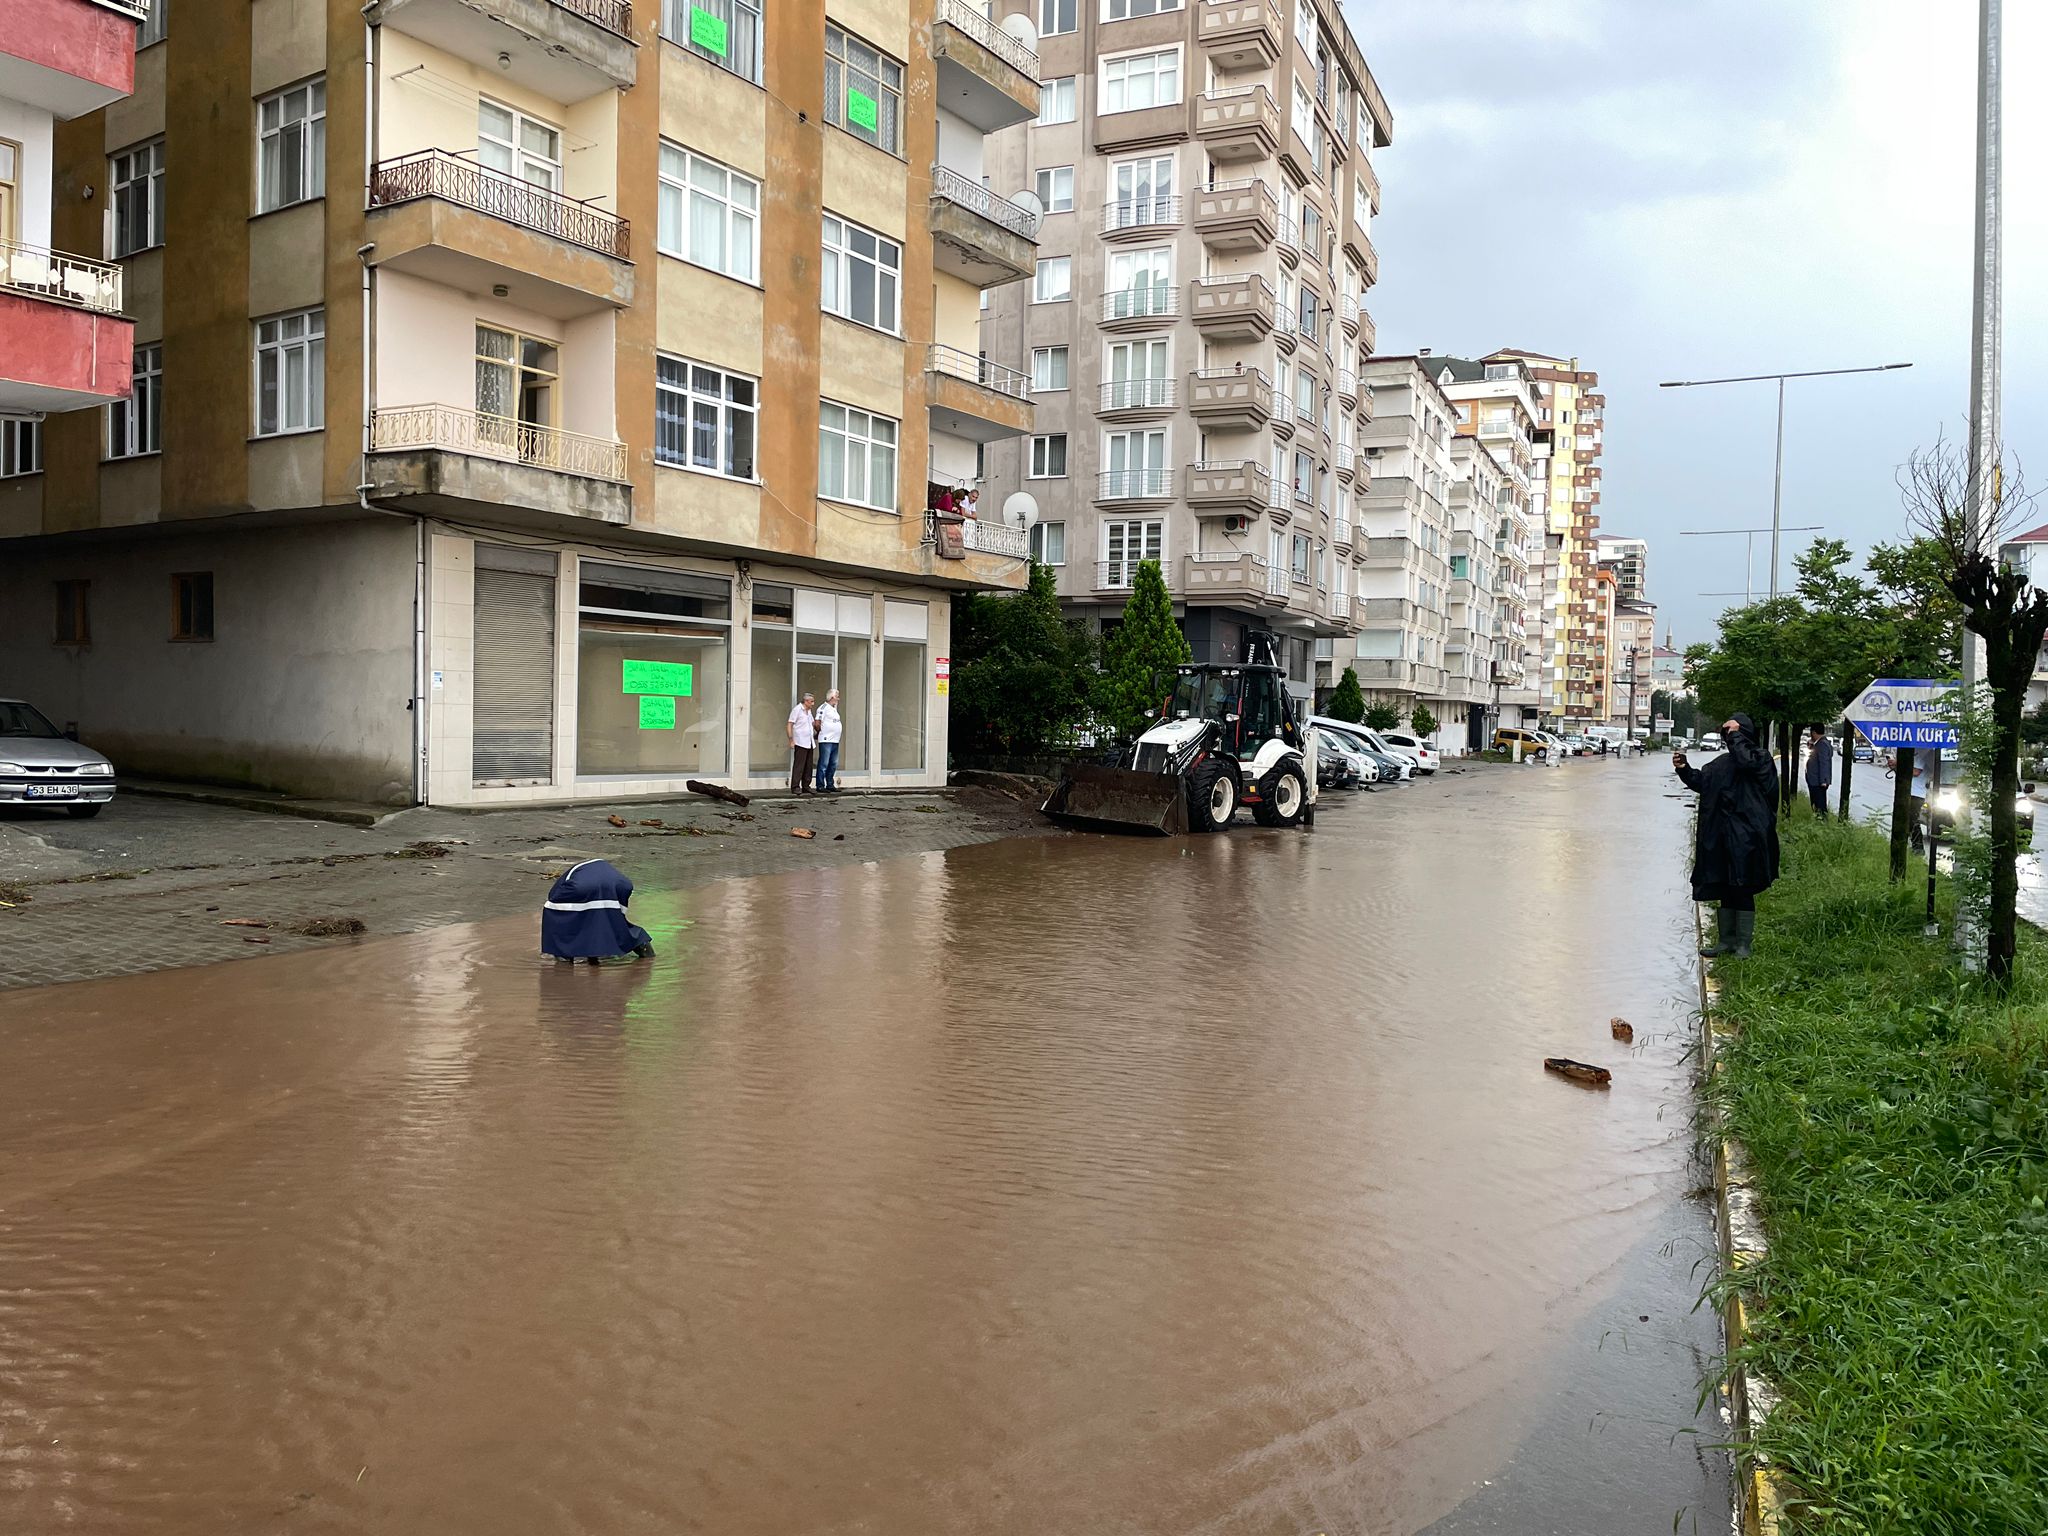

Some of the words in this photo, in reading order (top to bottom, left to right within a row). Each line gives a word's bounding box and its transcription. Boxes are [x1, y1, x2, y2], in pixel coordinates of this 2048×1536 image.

[1871, 724, 1913, 742] RABİA
[33, 786, 44, 794] 53
[47, 786, 59, 794] EH
[61, 786, 78, 794] 436
